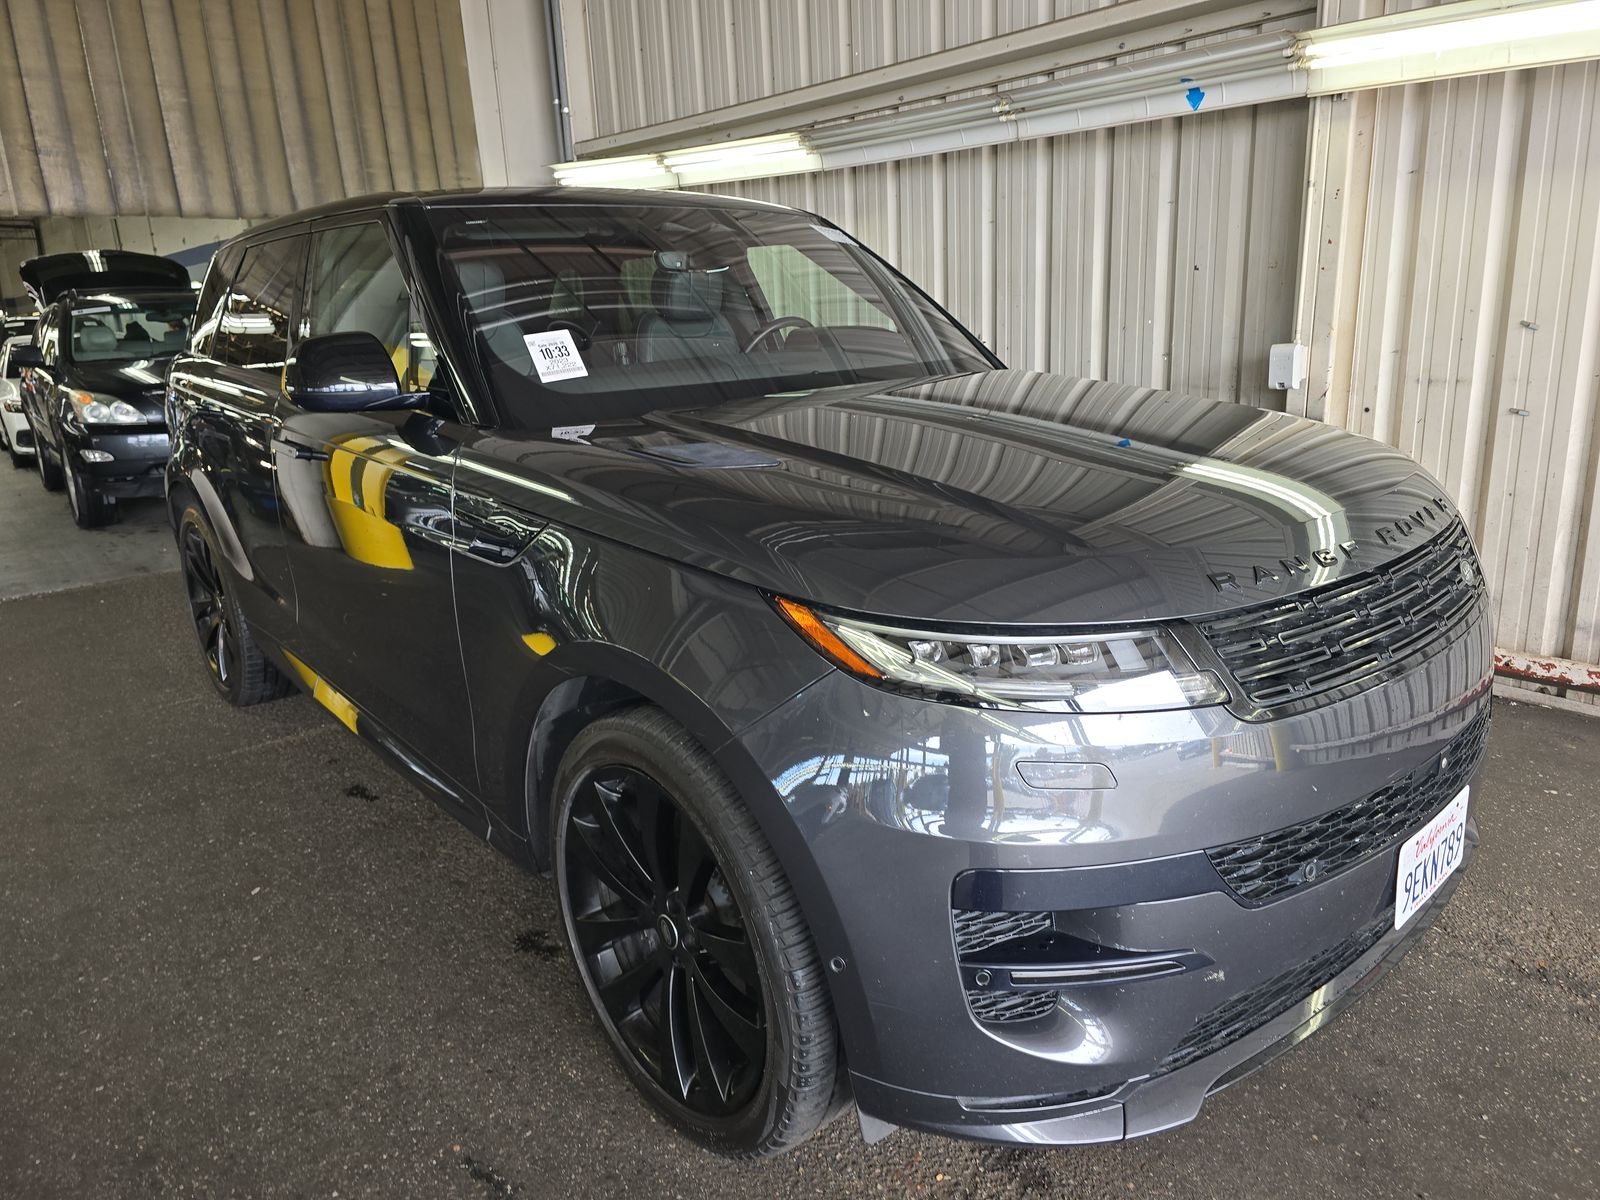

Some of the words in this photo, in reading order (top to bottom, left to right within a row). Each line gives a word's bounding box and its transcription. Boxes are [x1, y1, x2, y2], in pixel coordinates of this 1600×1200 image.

[539, 344, 570, 360] 10:33
[1206, 539, 1360, 593] RANGE
[1374, 496, 1449, 545] ROVER
[1402, 822, 1464, 914] 9EKN789
[1415, 813, 1457, 858] California
